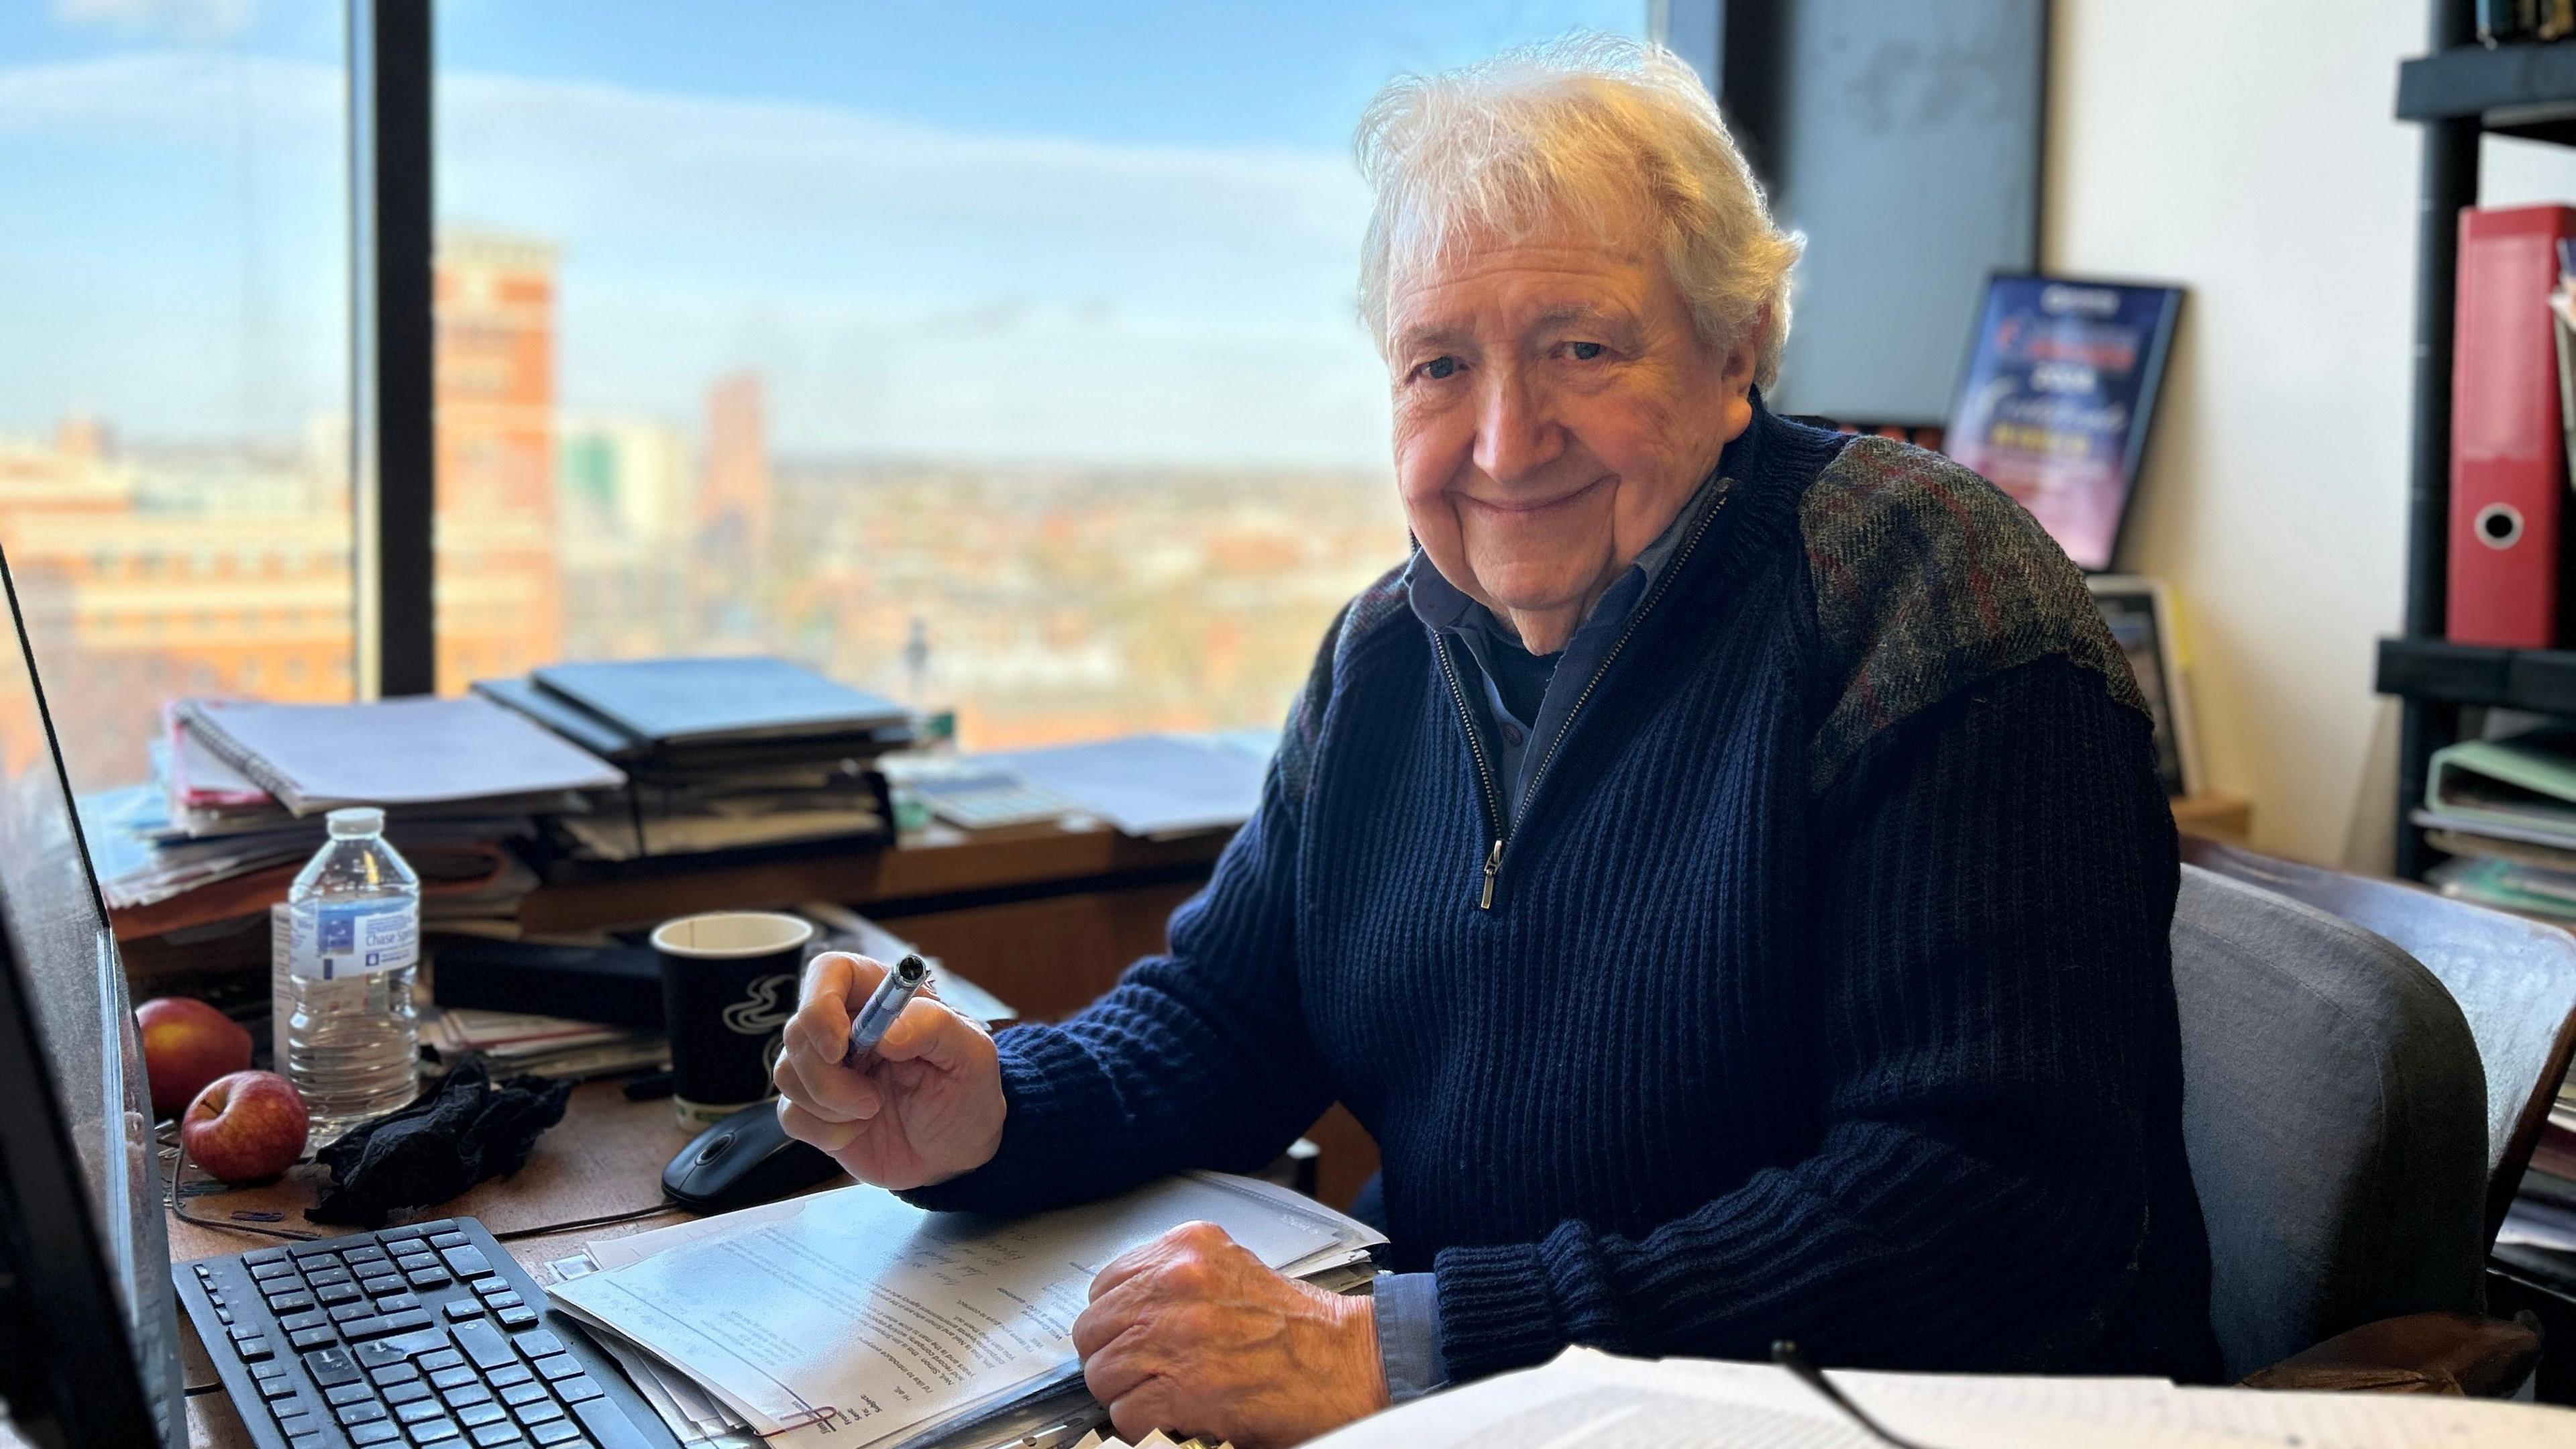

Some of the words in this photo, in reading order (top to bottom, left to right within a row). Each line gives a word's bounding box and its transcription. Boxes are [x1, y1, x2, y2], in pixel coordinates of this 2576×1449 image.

[366, 932, 395, 946] Chase
[941, 1328, 955, 1336] and
[907, 1347, 919, 1356] this
[931, 1342, 942, 1351] the
[991, 1342, 1004, 1351] can
[971, 1348, 983, 1359] this
[1002, 1350, 1016, 1360] you
[880, 1350, 909, 1373] introduce
[932, 1355, 953, 1372] record
[945, 1354, 959, 1364] and
[921, 1358, 941, 1375] Simon
[957, 1363, 976, 1378] years
[950, 1371, 965, 1381] and
[913, 1377, 926, 1387] like
[922, 1385, 934, 1393] I'd
[860, 1395, 882, 1413] Subject:
[818, 1422, 831, 1434] Jim
